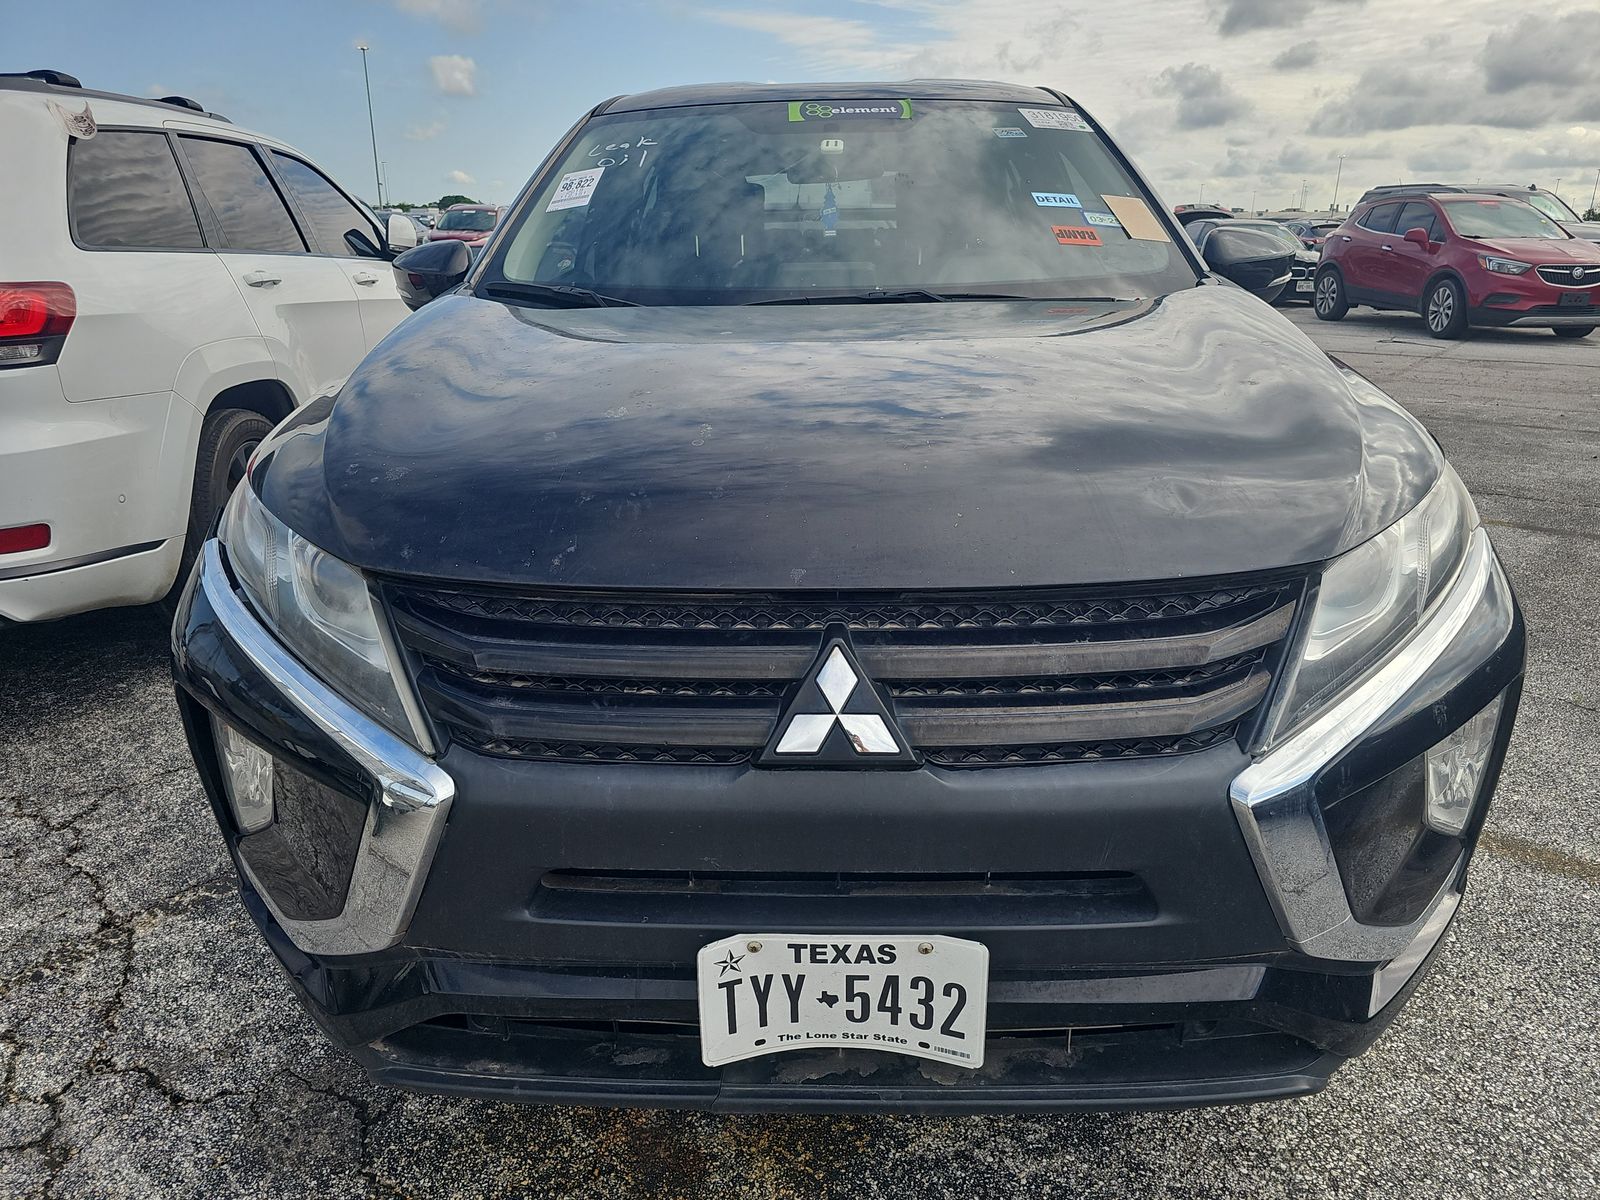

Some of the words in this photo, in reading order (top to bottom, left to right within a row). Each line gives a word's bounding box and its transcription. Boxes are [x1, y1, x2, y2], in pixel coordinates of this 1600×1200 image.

[831, 105, 898, 114] element
[1036, 195, 1079, 205] DETAIL
[1055, 228, 1098, 241] RAMP
[787, 943, 897, 965] TEXAS
[717, 973, 806, 1035] TYY
[844, 974, 968, 1040] 5432
[777, 1033, 802, 1042] The
[806, 1032, 838, 1040] Lone
[841, 1032, 870, 1041] Star
[873, 1033, 908, 1045] State
